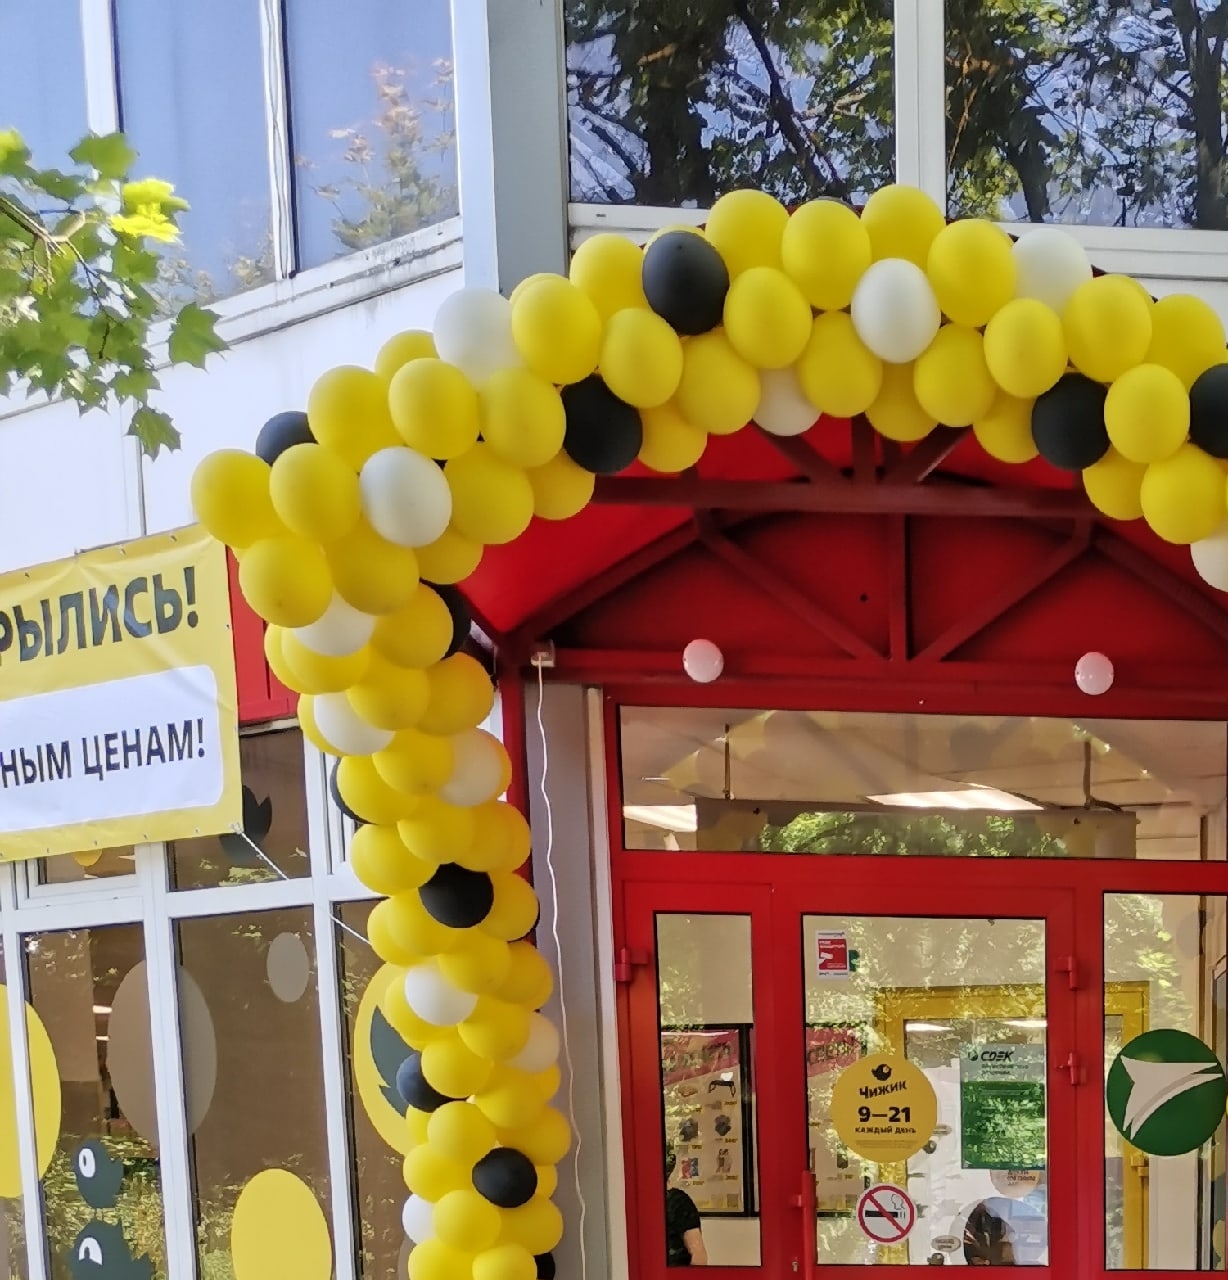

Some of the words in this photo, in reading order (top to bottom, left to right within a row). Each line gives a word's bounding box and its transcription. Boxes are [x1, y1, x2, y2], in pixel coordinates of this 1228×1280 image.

[82, 718, 205, 781] ЦЕНАМ!
[980, 1050, 1015, 1062] CDEK
[855, 1125, 893, 1135] каждый
[894, 1126, 917, 1135] день
